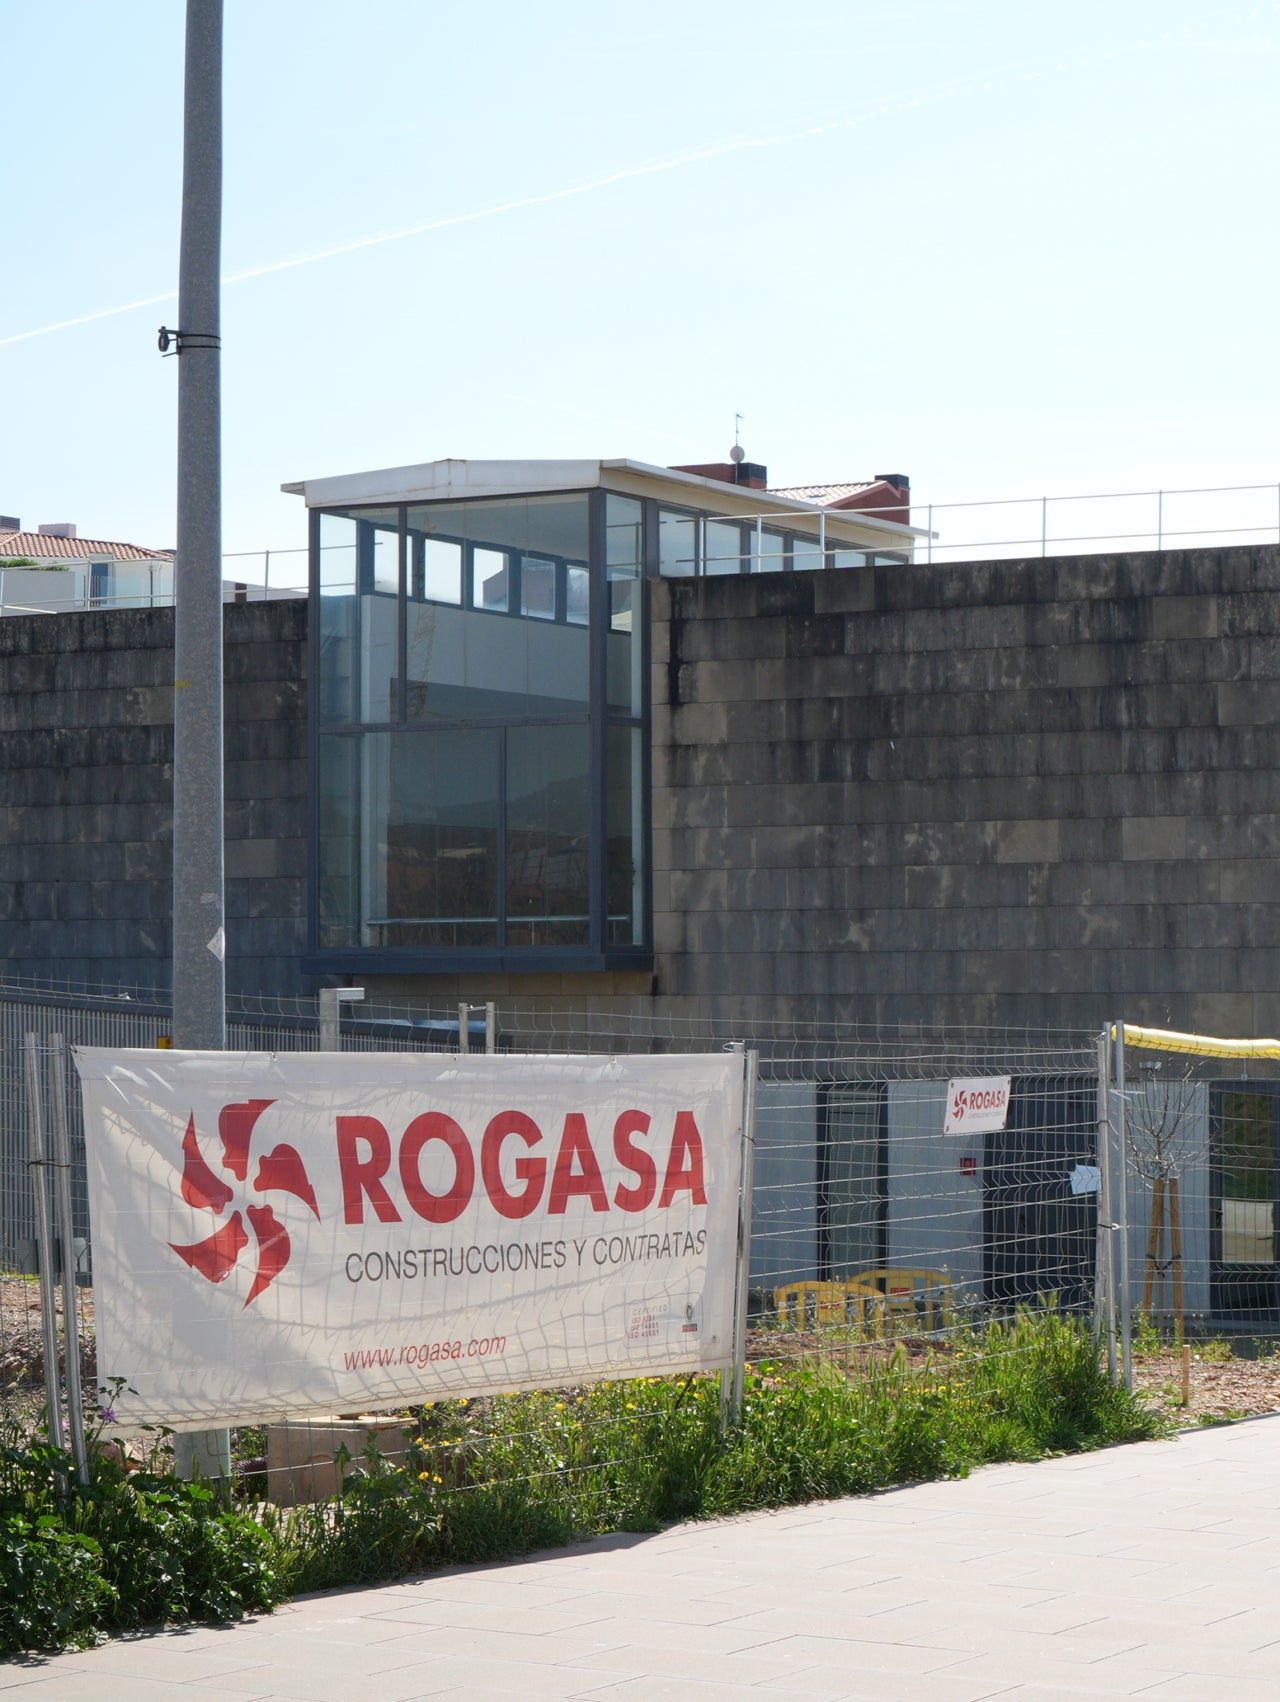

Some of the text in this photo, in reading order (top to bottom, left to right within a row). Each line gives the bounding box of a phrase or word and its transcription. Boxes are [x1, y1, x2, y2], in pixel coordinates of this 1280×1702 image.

[969, 1090, 1005, 1110] ROGASA
[336, 1110, 708, 1225] ROGASA
[345, 1229, 708, 1283] CONSTRUCCIONES Y CONTRATAS
[344, 1335, 507, 1371] www.rogasa.com
